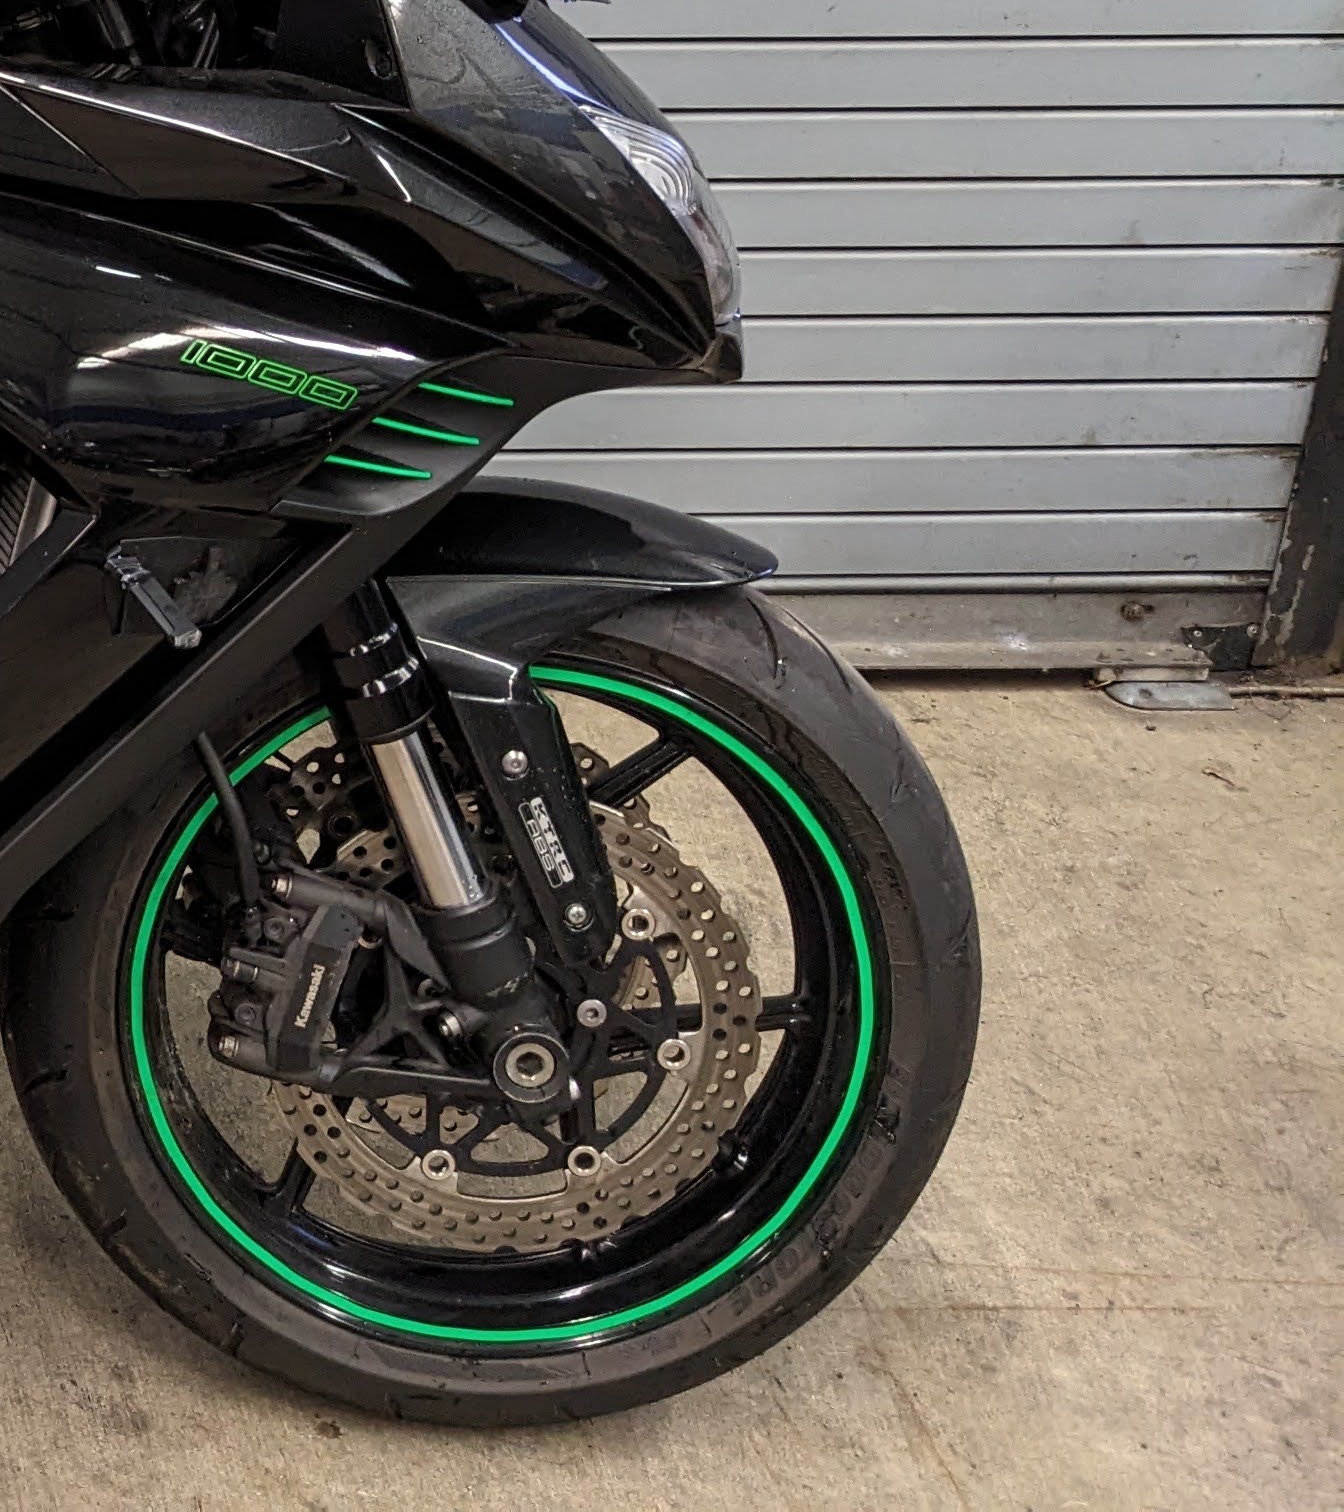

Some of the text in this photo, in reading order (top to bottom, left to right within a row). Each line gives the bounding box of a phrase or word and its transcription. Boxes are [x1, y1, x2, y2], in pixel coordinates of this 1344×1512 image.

[181, 340, 358, 410] 1000
[526, 819, 554, 872] ABS
[294, 963, 325, 1028] Kawasaki
